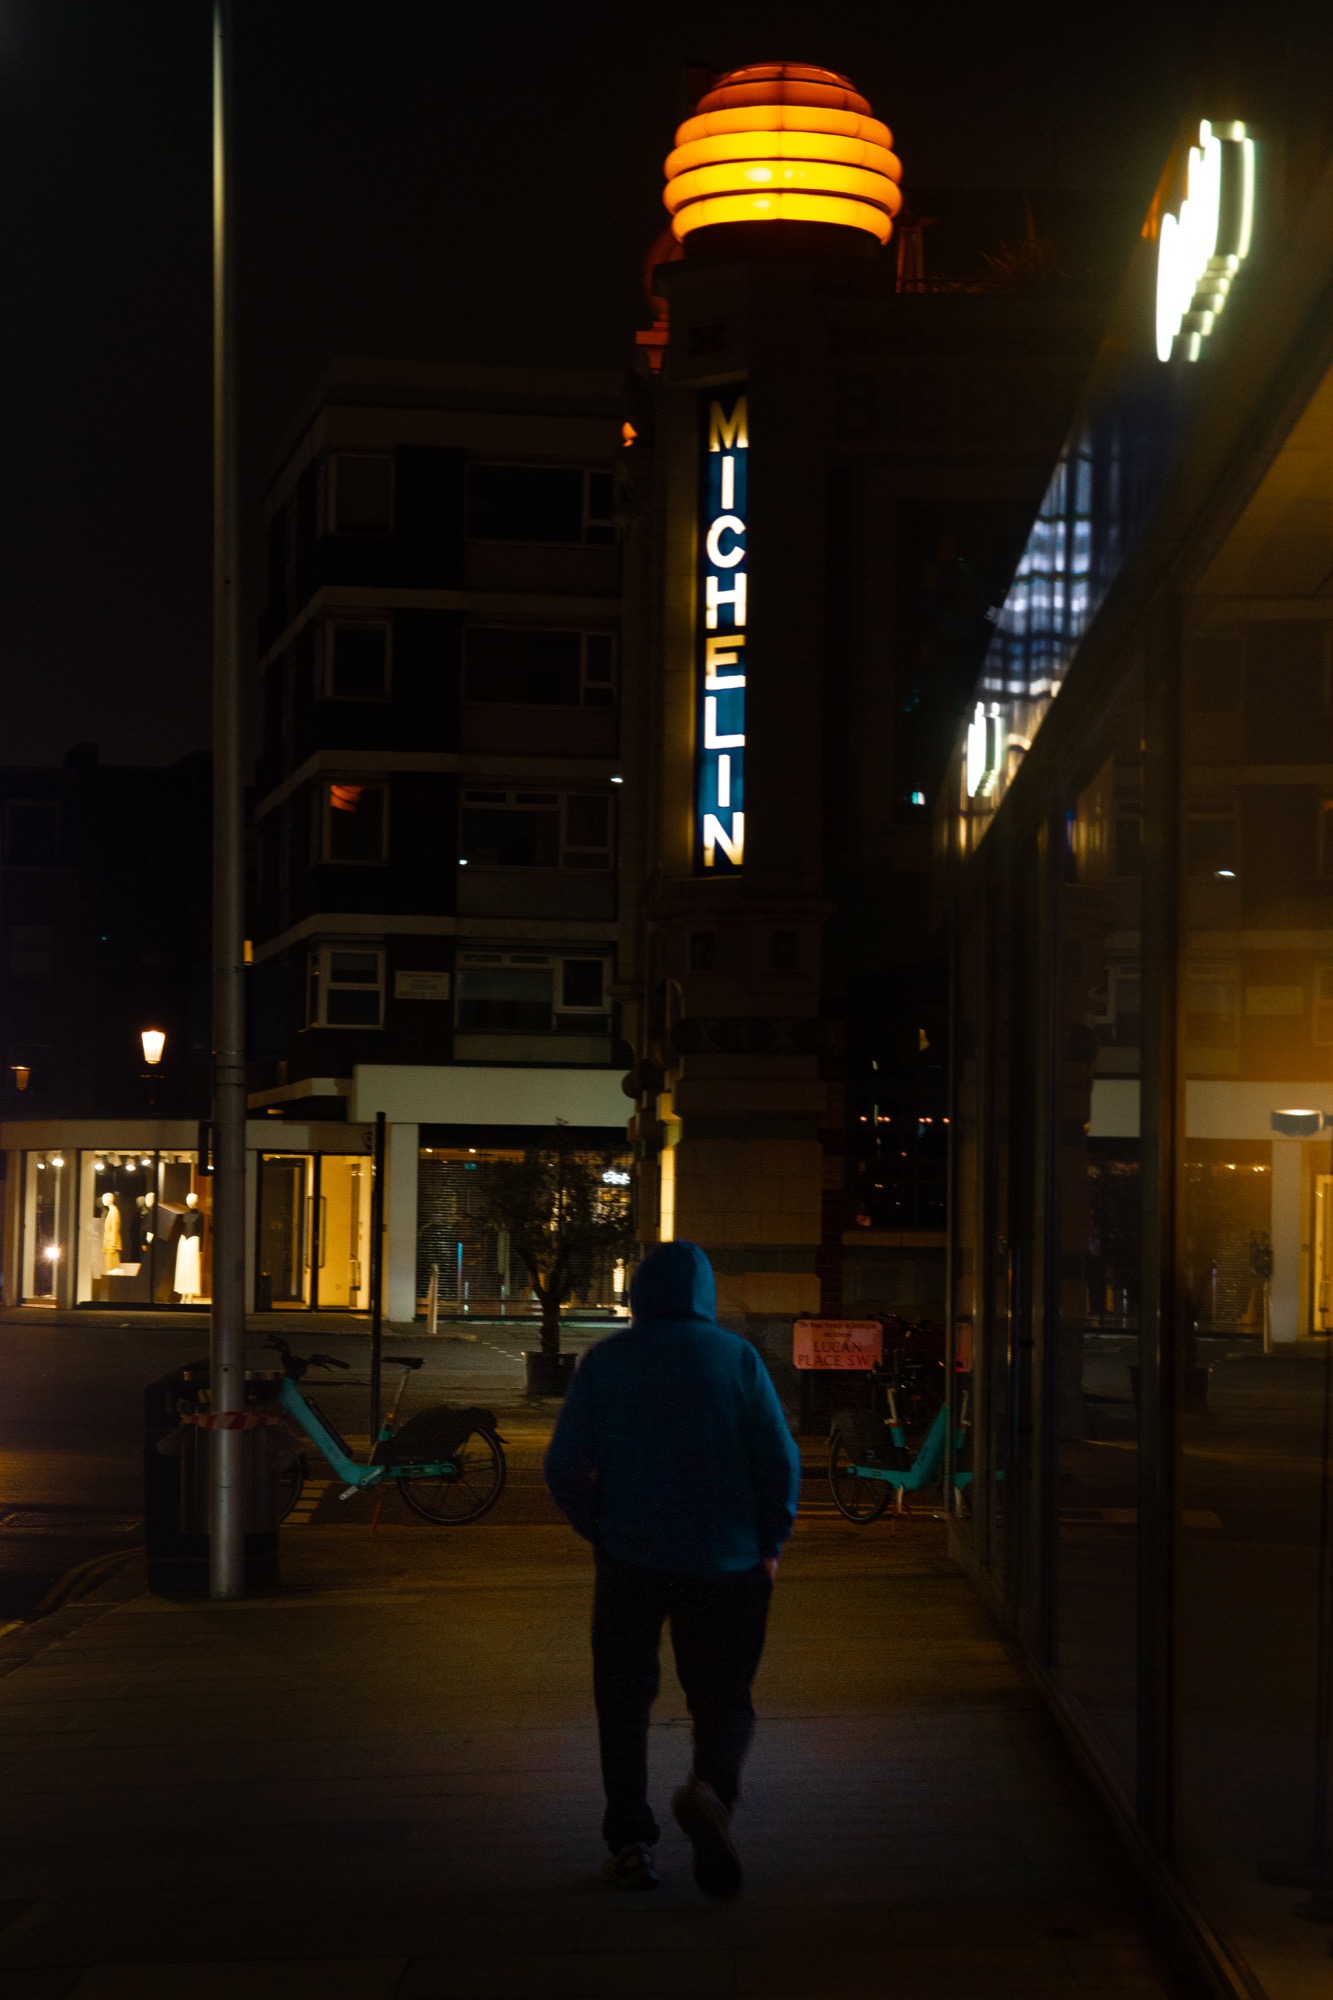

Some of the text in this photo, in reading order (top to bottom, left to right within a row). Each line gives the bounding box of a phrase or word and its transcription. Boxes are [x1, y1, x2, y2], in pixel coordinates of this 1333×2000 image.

[703, 396, 749, 867] MICHELIN
[813, 1341, 862, 1353] LUCAN
[797, 1354, 842, 1366] PLACE
